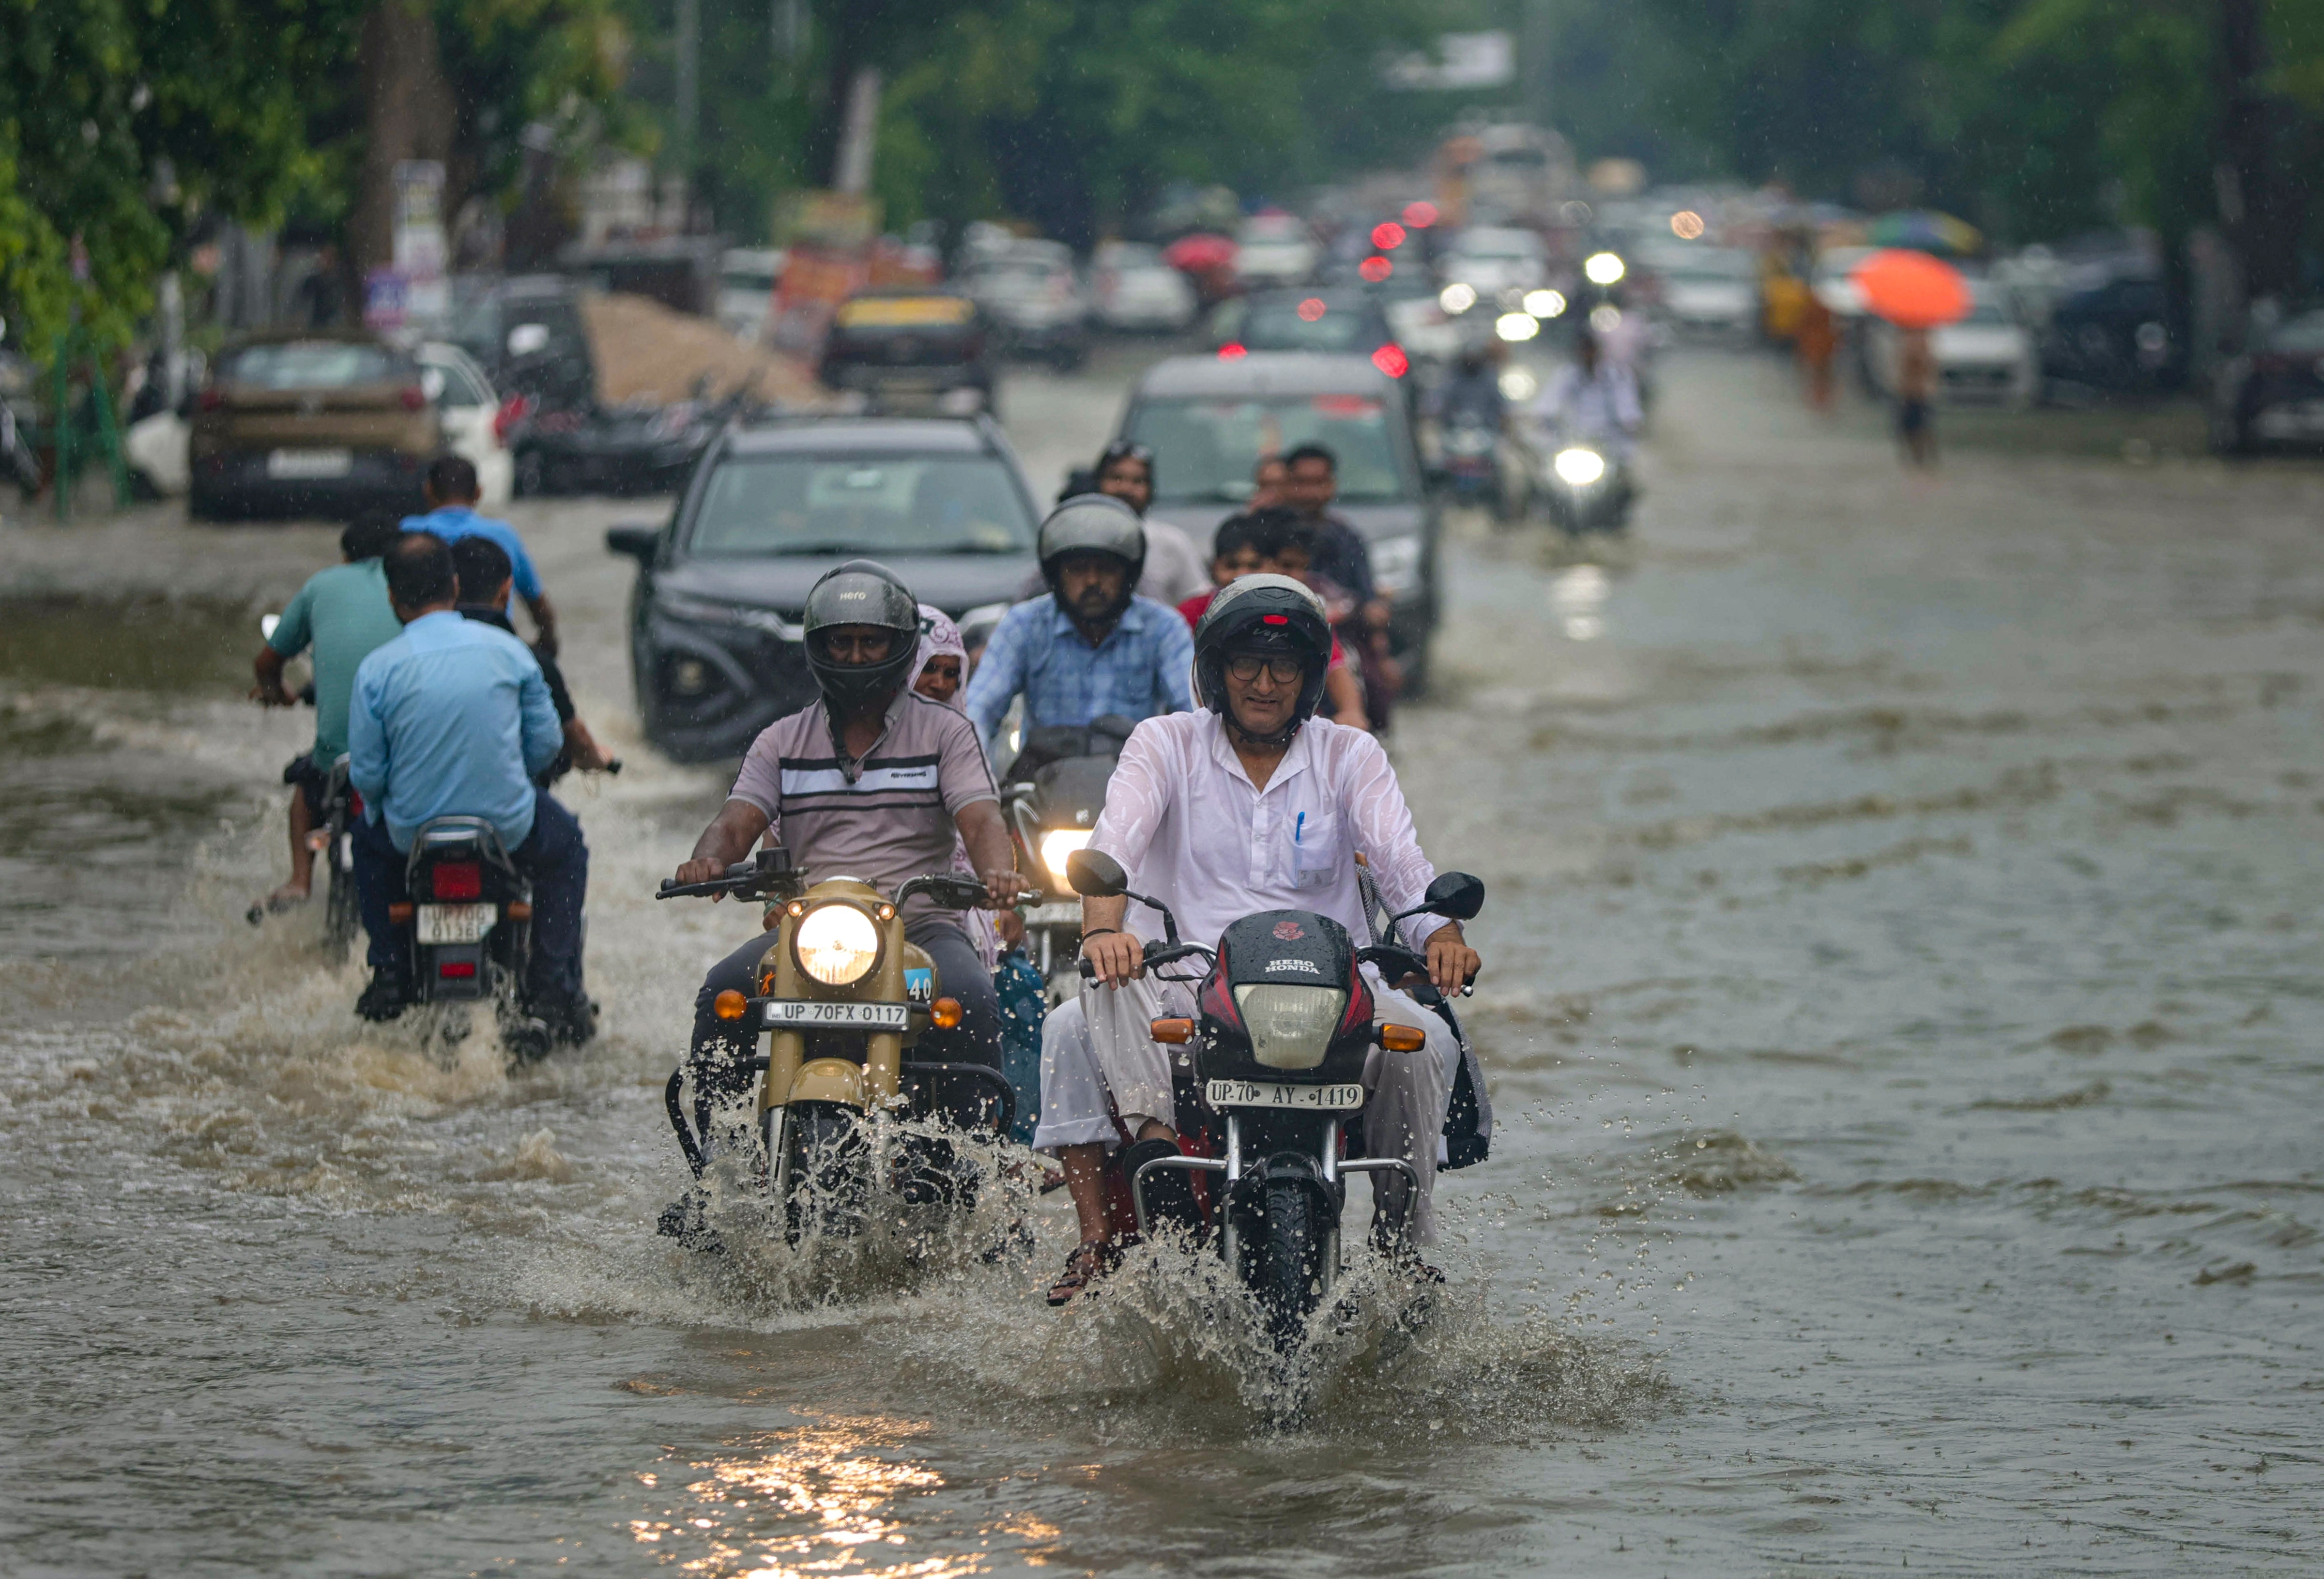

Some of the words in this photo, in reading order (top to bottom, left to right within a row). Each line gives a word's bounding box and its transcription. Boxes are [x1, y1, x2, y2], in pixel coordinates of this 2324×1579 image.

[1265, 965, 1320, 975] HONDA
[909, 977, 932, 1000] 40
[863, 1007, 905, 1023] 0117
